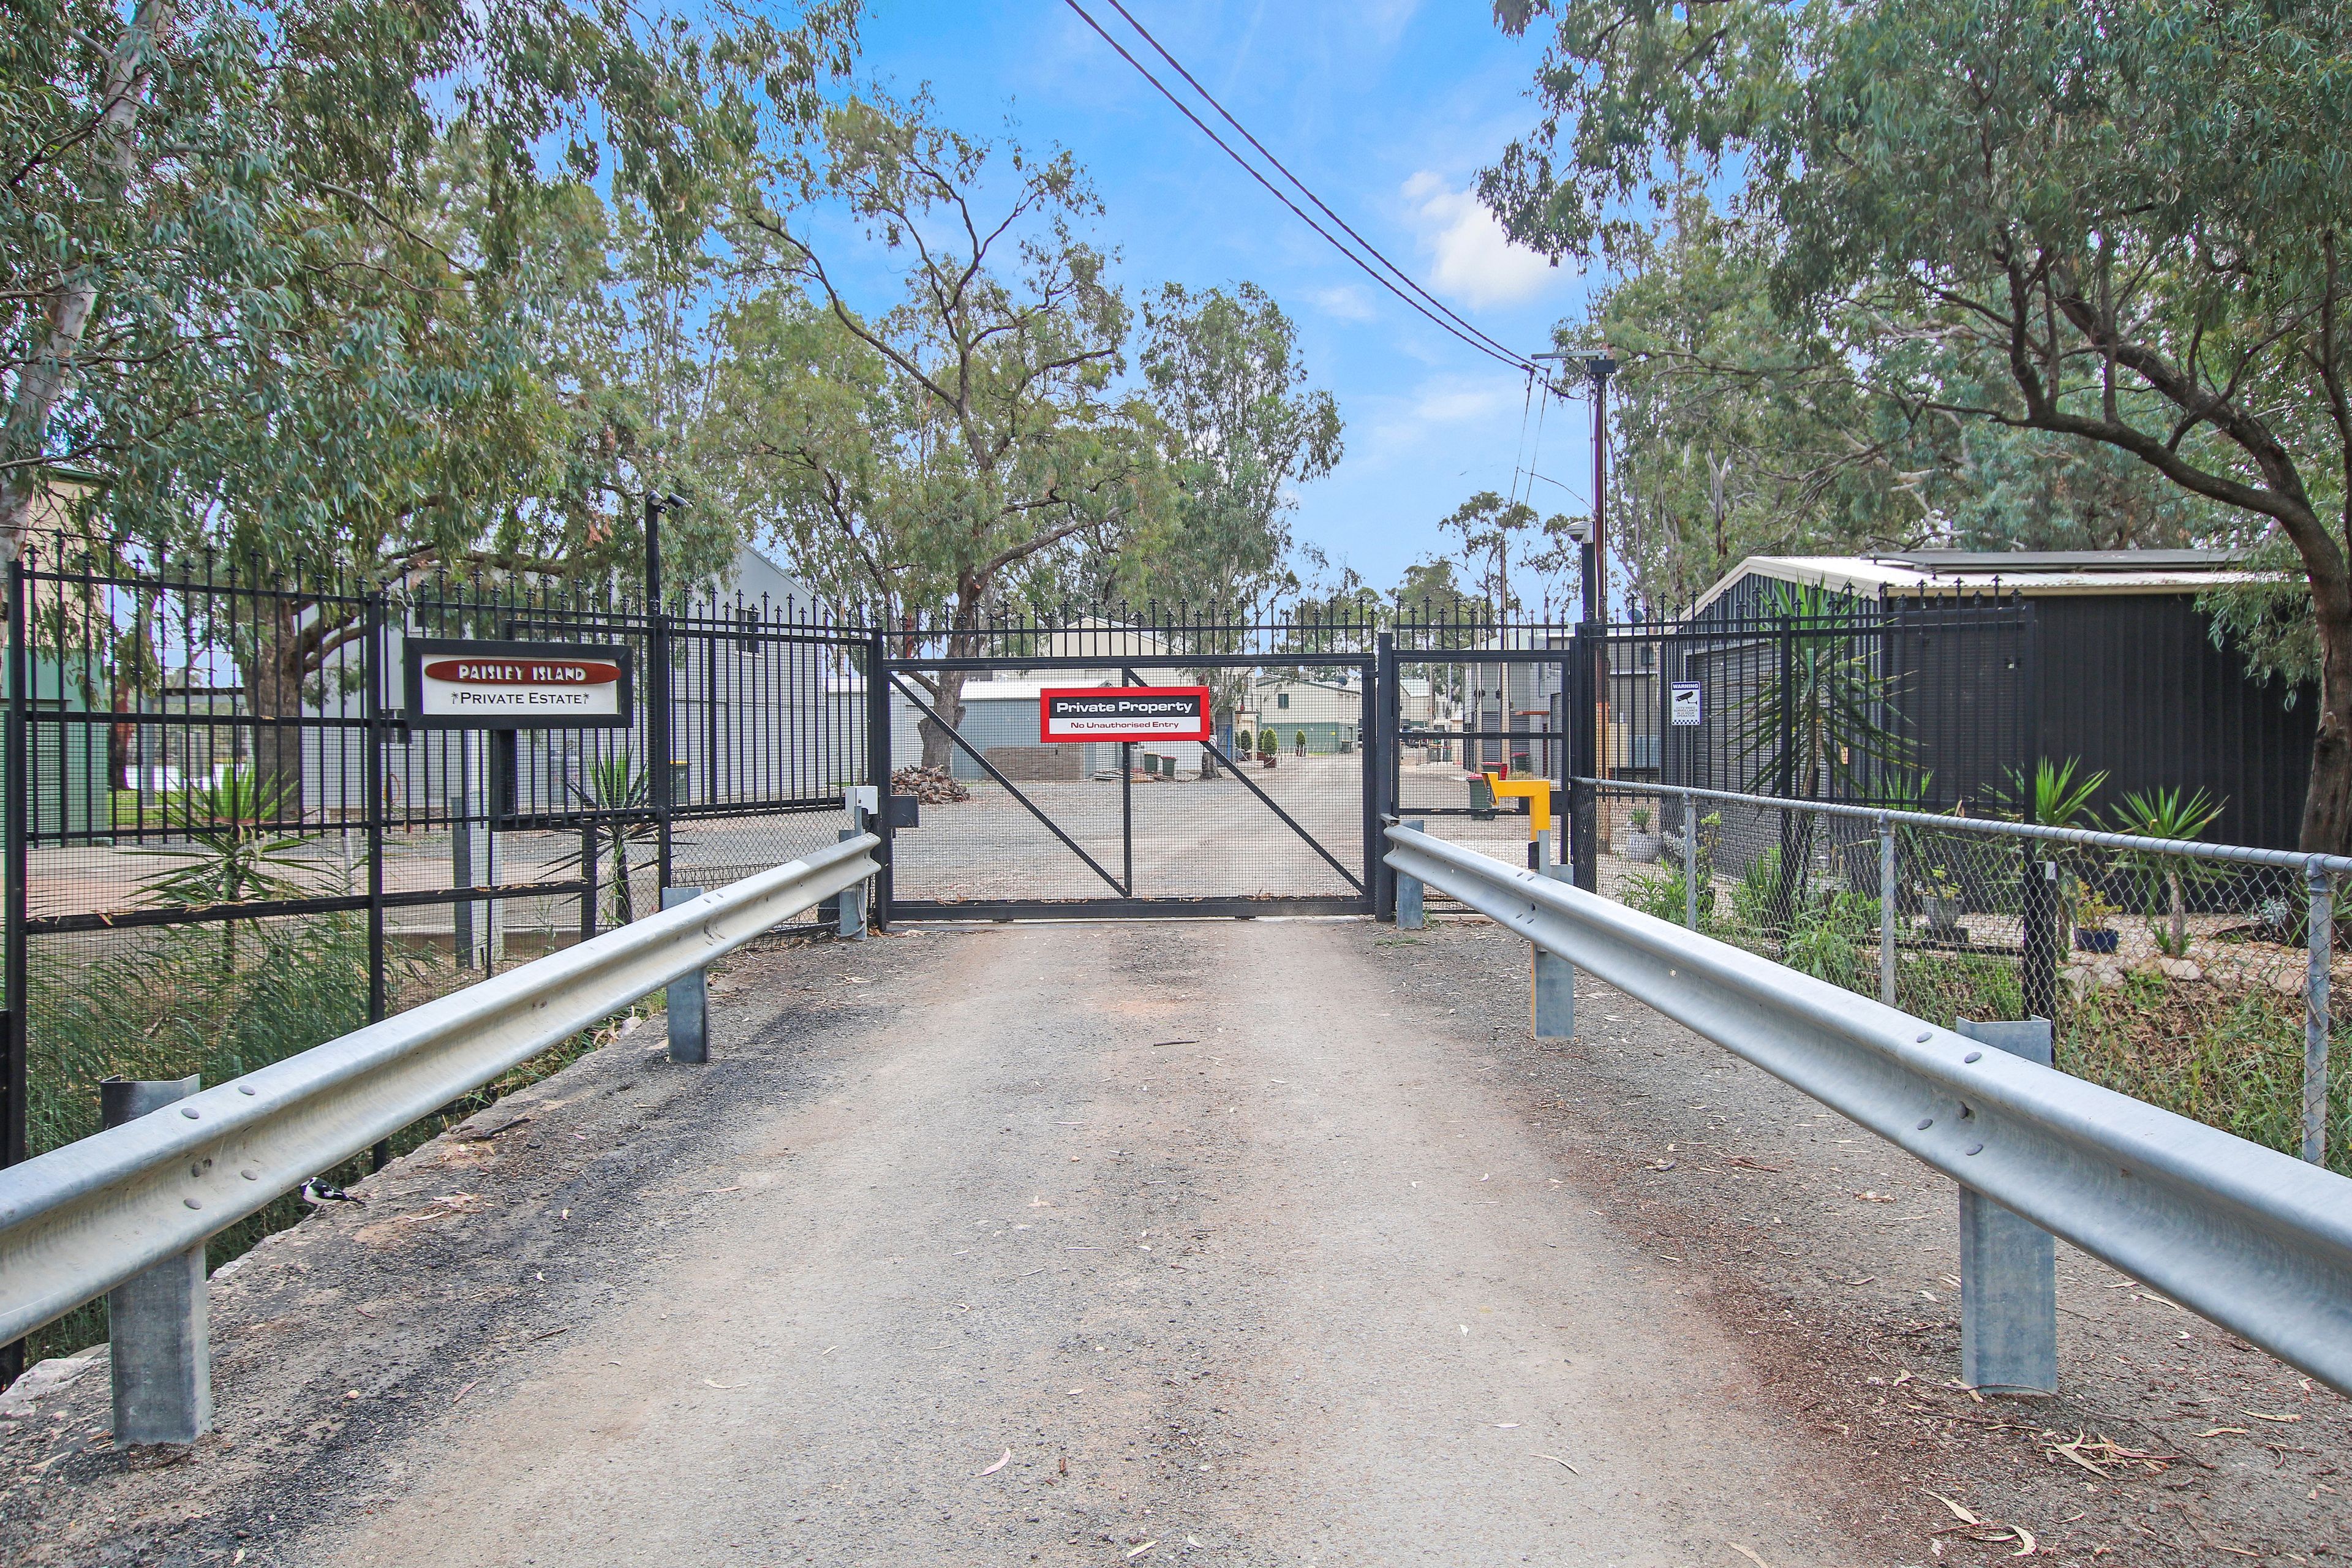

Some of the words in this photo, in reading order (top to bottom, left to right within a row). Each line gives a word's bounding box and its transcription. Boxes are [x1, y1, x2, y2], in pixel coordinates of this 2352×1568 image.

[458, 664, 524, 680] PAISLEY
[532, 666, 587, 682] ISLAND
[461, 692, 524, 704] PRIVATE
[529, 692, 582, 704] ESTATE
[1057, 702, 1115, 713] Private
[1118, 701, 1193, 714] Property
